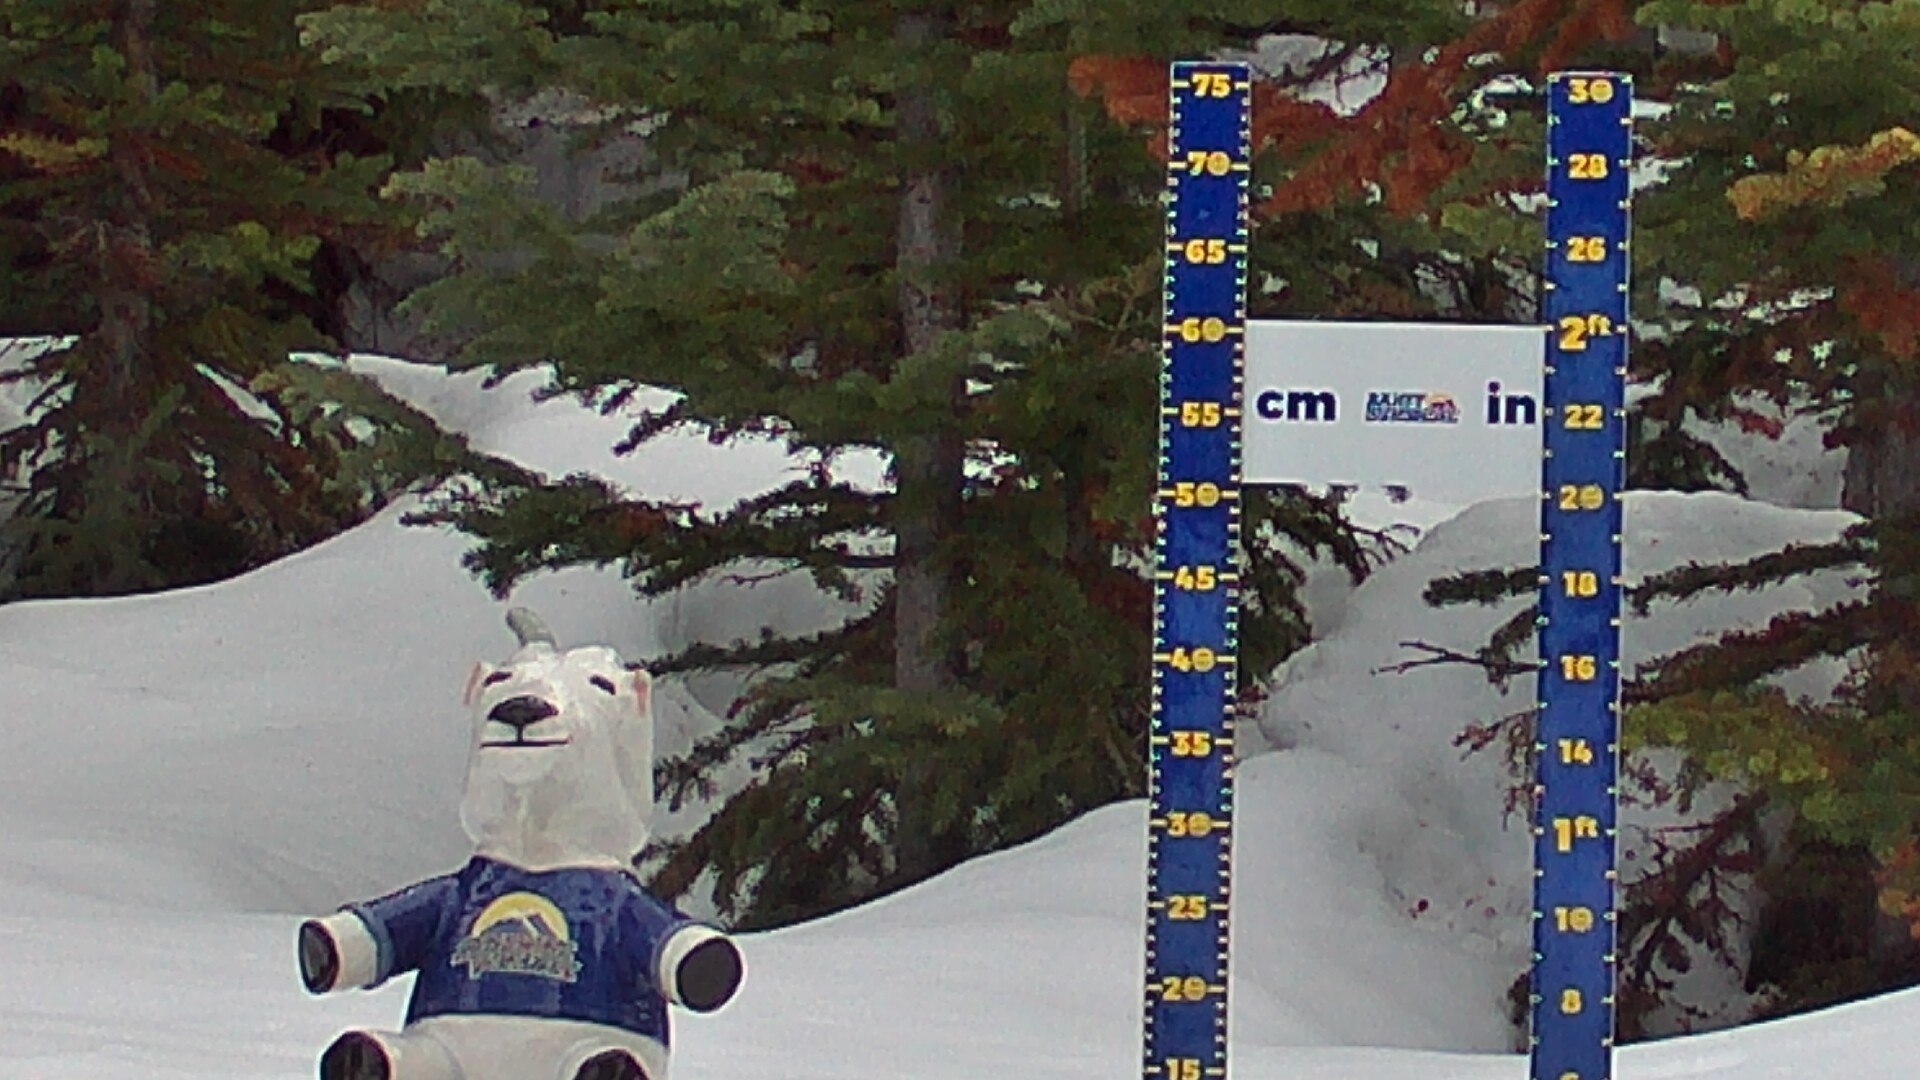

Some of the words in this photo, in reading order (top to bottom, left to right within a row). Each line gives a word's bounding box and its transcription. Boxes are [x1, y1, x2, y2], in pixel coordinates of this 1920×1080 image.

[1191, 73, 1231, 98] 75
[1568, 78, 1614, 104] 30
[1187, 151, 1231, 175] 70
[1568, 153, 1608, 180] 28
[1185, 239, 1226, 264] 65
[1566, 237, 1606, 262] 26
[1180, 318, 1226, 343] 60
[1179, 402, 1221, 428] 55
[1256, 390, 1337, 420] cm
[1487, 381, 1536, 424] in
[1563, 404, 1604, 429] 22
[1174, 482, 1220, 507] 50
[1560, 486, 1604, 511] 20
[1172, 567, 1216, 592] 45
[1169, 648, 1215, 672] 40
[1560, 655, 1596, 681] 16
[1170, 731, 1211, 758] 35
[1558, 740, 1594, 765] 14
[1166, 812, 1214, 838] 30
[1166, 895, 1208, 921] 25
[1554, 905, 1594, 932] 10
[1162, 975, 1209, 1002] 20
[1560, 989, 1582, 1014] 8
[1166, 1059, 1201, 1080] 15
